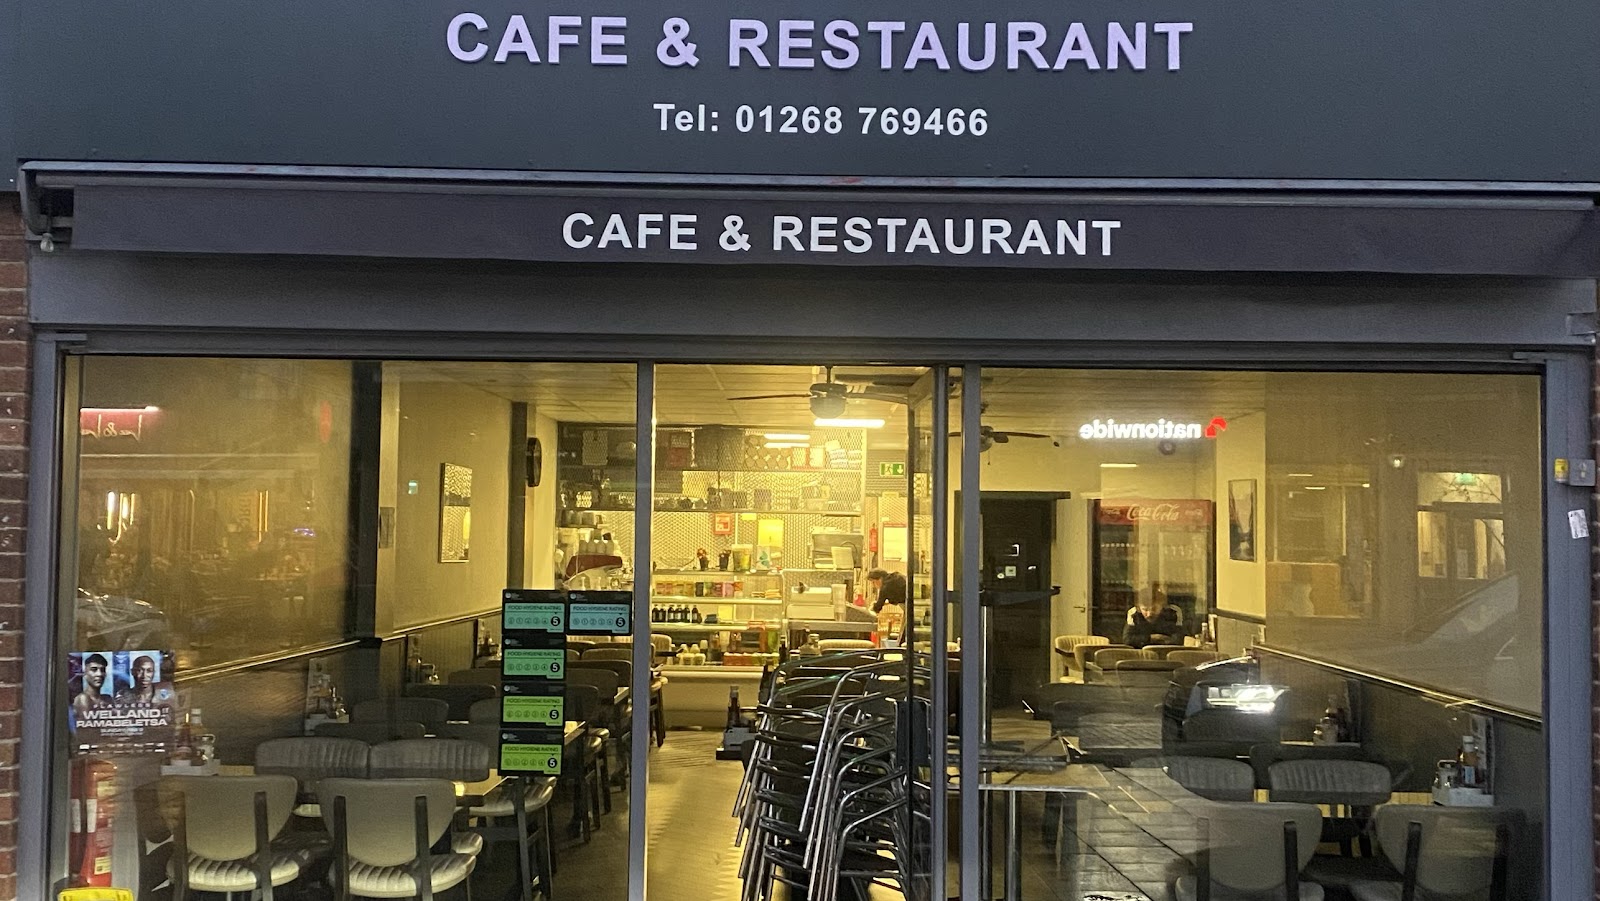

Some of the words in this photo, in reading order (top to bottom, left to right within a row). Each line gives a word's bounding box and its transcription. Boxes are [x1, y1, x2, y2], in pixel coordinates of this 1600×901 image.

[446, 12, 628, 65] CAFE
[656, 18, 700, 67] &
[729, 19, 1194, 72] RESTAURANT
[653, 103, 719, 132] Tel:
[735, 105, 843, 134] 01268
[858, 107, 988, 136] 769466
[562, 212, 698, 251] CAFE
[718, 214, 752, 252] &
[773, 215, 1122, 256] RESTAURANT
[552, 617, 559, 625] 5
[617, 618, 624, 626] 5
[552, 663, 559, 671] 5
[83, 709, 161, 719] WELLAND
[551, 711, 558, 719] 5
[76, 719, 168, 728] RAMABELETSA
[549, 759, 556, 767] 5
